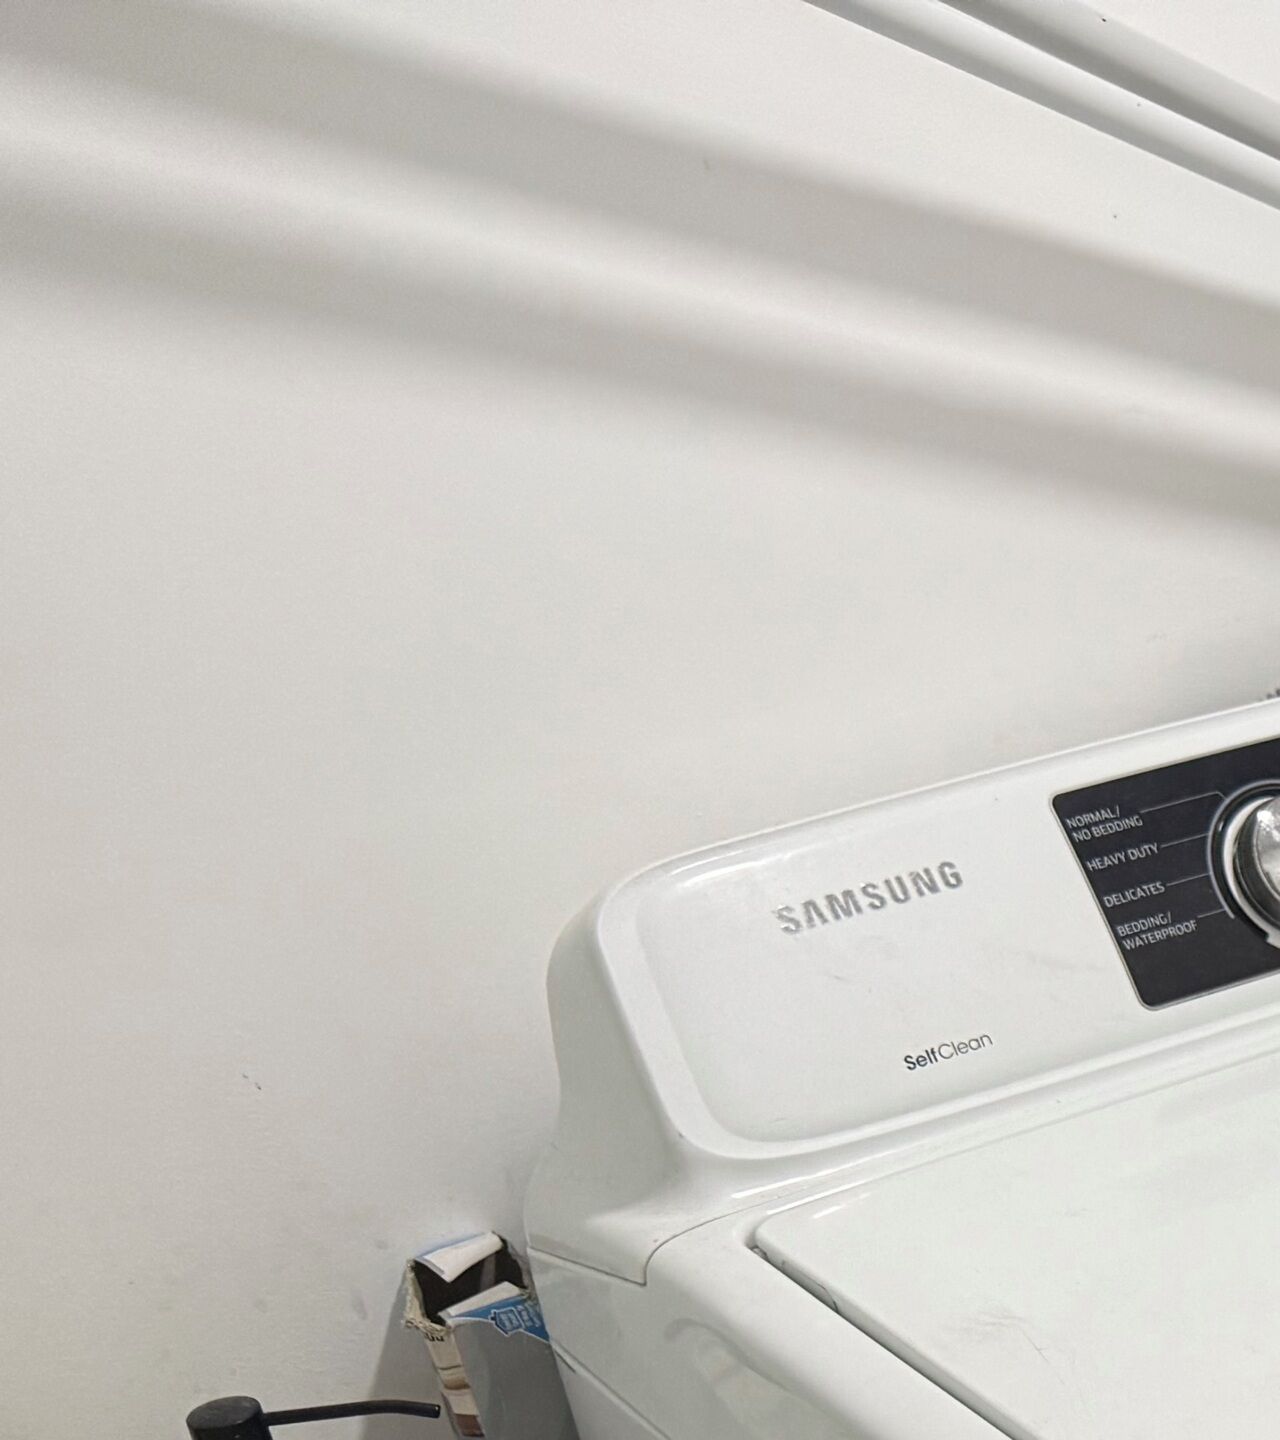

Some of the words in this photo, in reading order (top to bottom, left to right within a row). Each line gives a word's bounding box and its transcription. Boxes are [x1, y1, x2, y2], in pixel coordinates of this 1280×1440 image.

[1065, 805, 1122, 829] NORMAL/
[1072, 828, 1092, 843] NO
[1092, 814, 1143, 839] BEDDING
[1086, 851, 1126, 872] HEAVY
[1126, 841, 1159, 862] DUTY
[771, 860, 964, 936] SAMSUNG
[1103, 881, 1165, 908] DELICATES
[1116, 911, 1174, 938] BEDDING/
[1121, 919, 1198, 953] WATERPROOF
[903, 1031, 993, 1071] SelfClean
